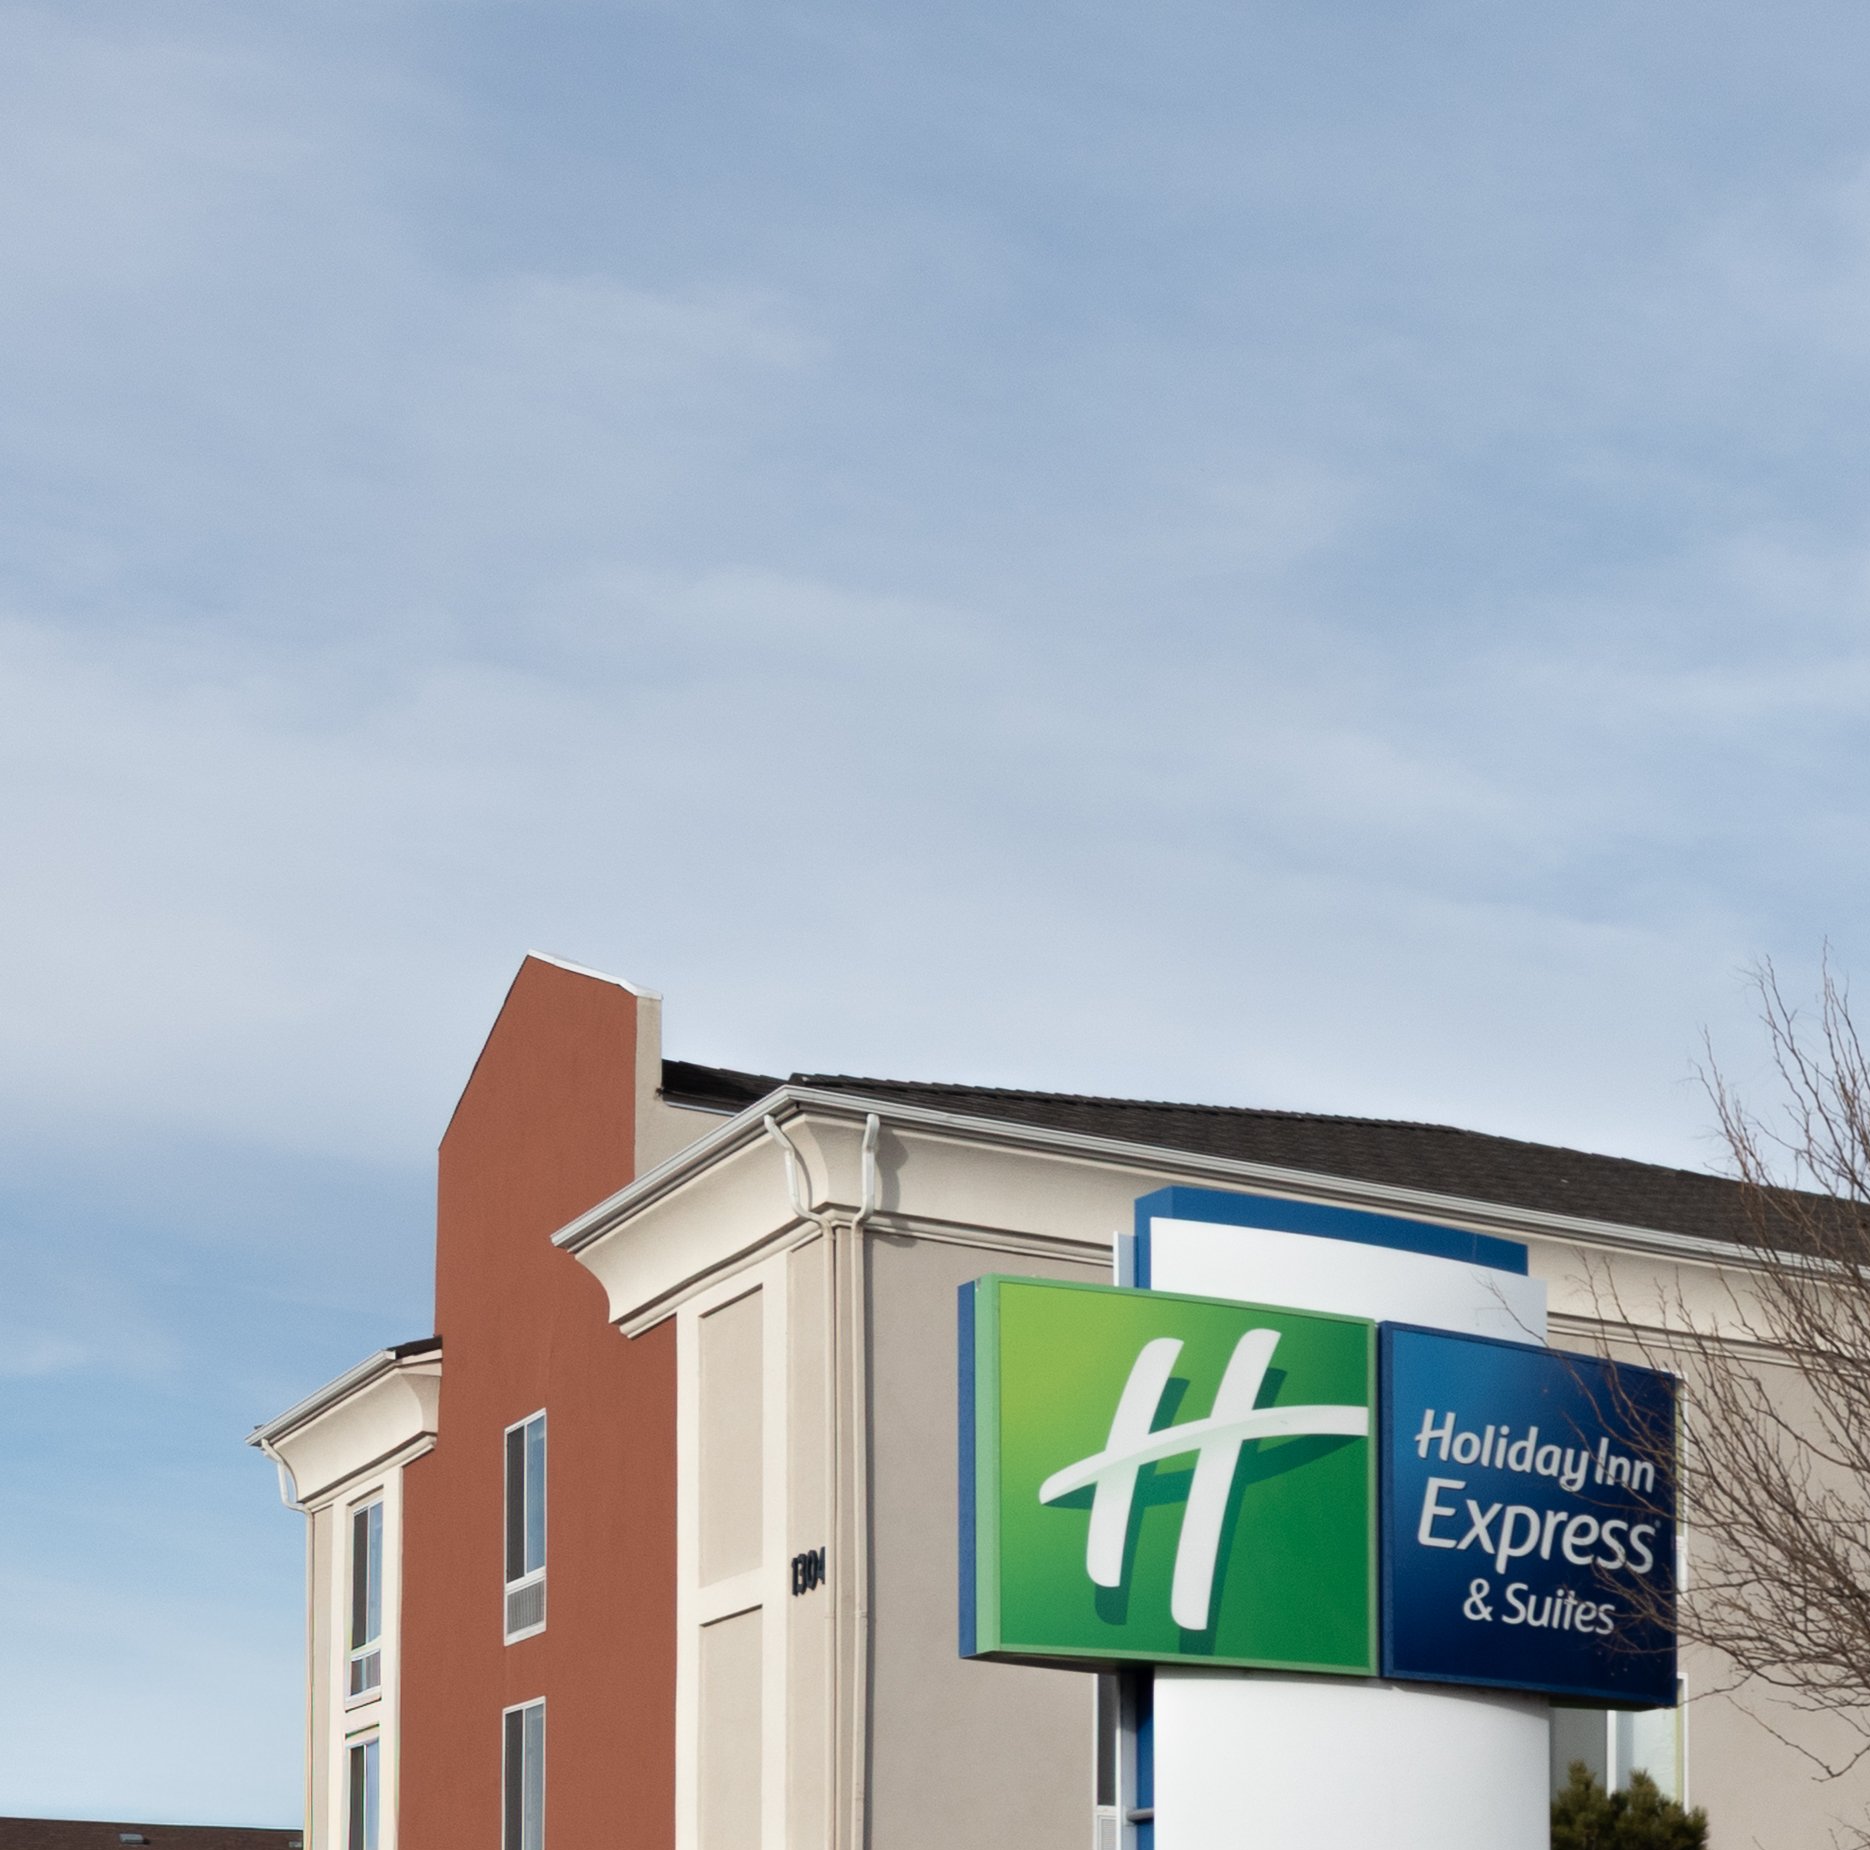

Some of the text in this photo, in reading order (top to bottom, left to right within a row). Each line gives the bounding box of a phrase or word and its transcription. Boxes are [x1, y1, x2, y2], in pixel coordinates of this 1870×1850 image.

[1039, 1328, 1369, 1630] H
[1414, 1408, 1656, 1494] Holiday Inn
[1417, 1476, 1657, 1576] Express
[791, 1545, 826, 1597] 1304
[1462, 1578, 1616, 1636] & Suites
